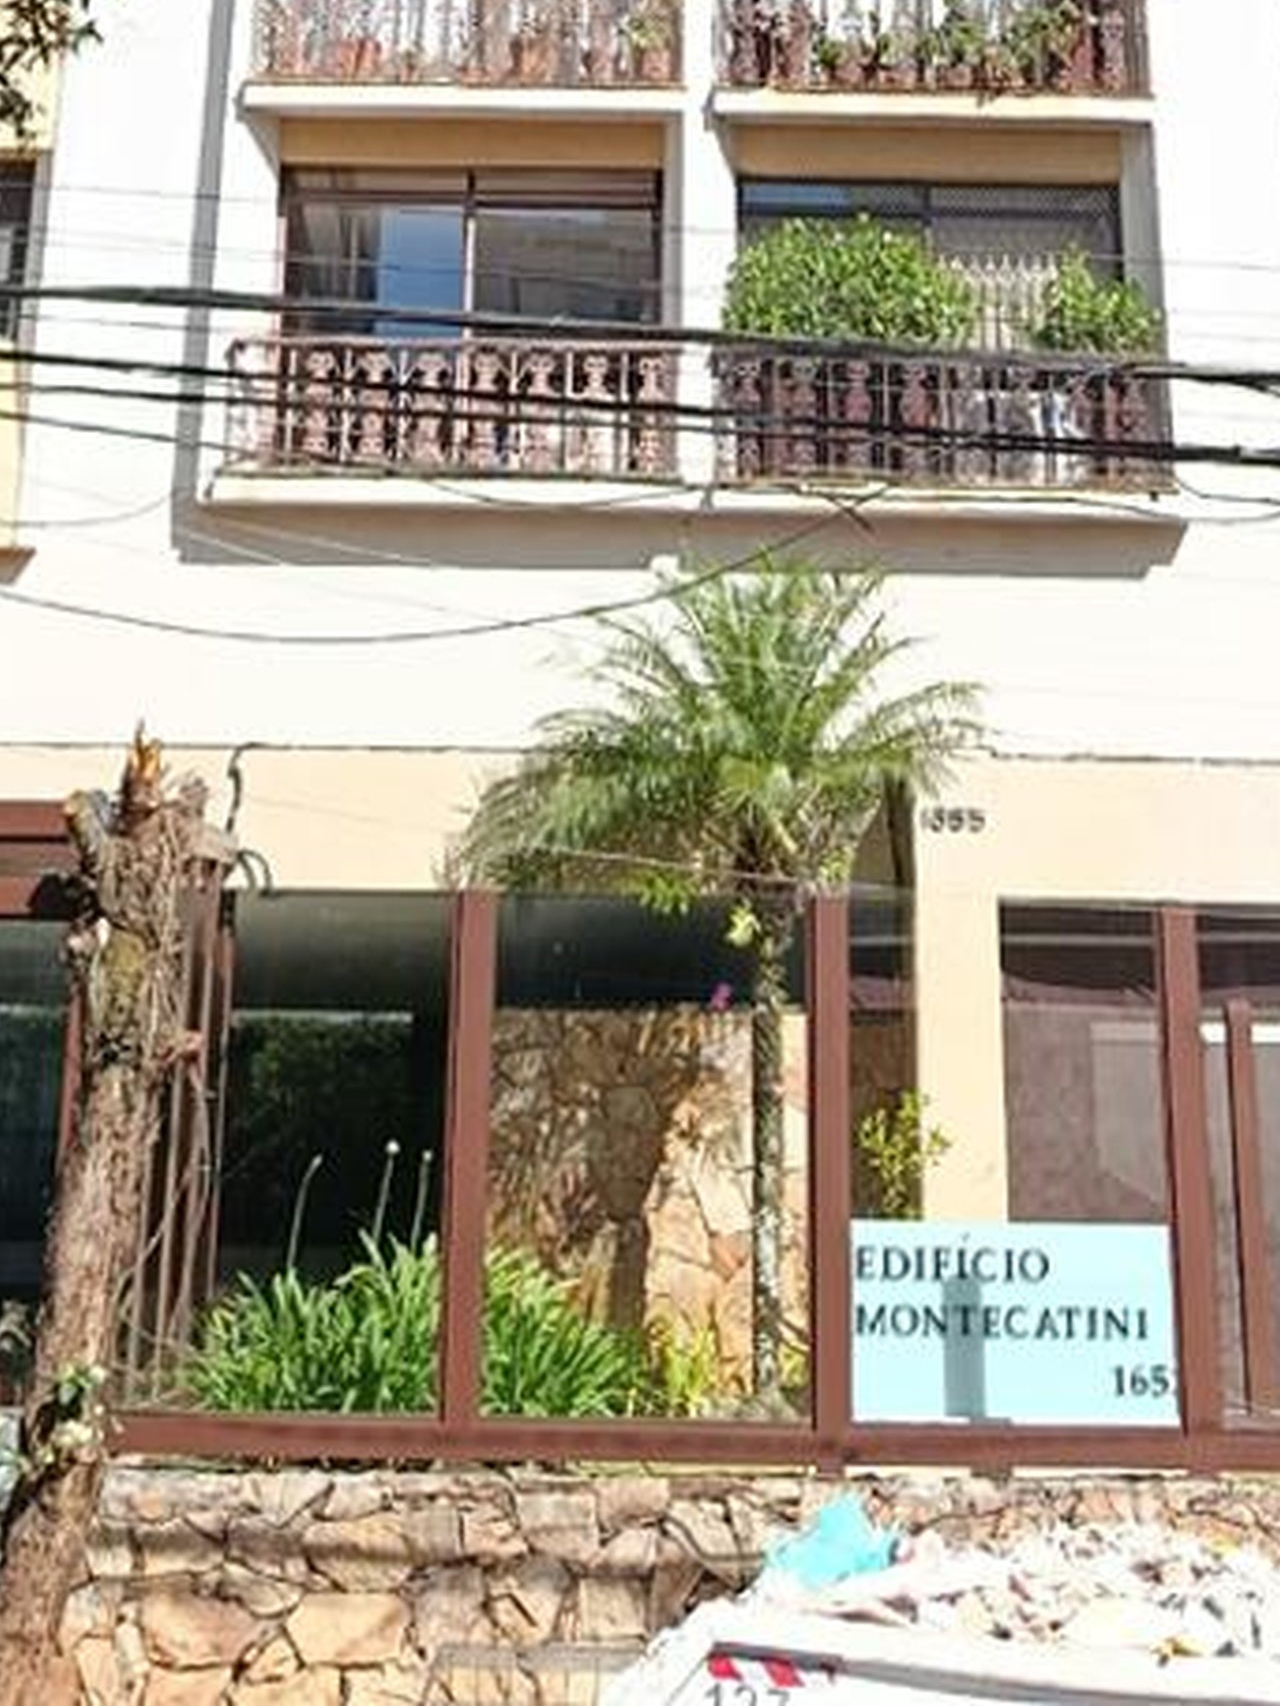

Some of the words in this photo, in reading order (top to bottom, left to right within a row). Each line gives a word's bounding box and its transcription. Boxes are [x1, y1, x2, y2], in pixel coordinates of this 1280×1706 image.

[855, 1233, 1050, 1282] EDIFÍCIO
[855, 1304, 1149, 1340] MONTECATINI
[1113, 1364, 1179, 1398] 165
